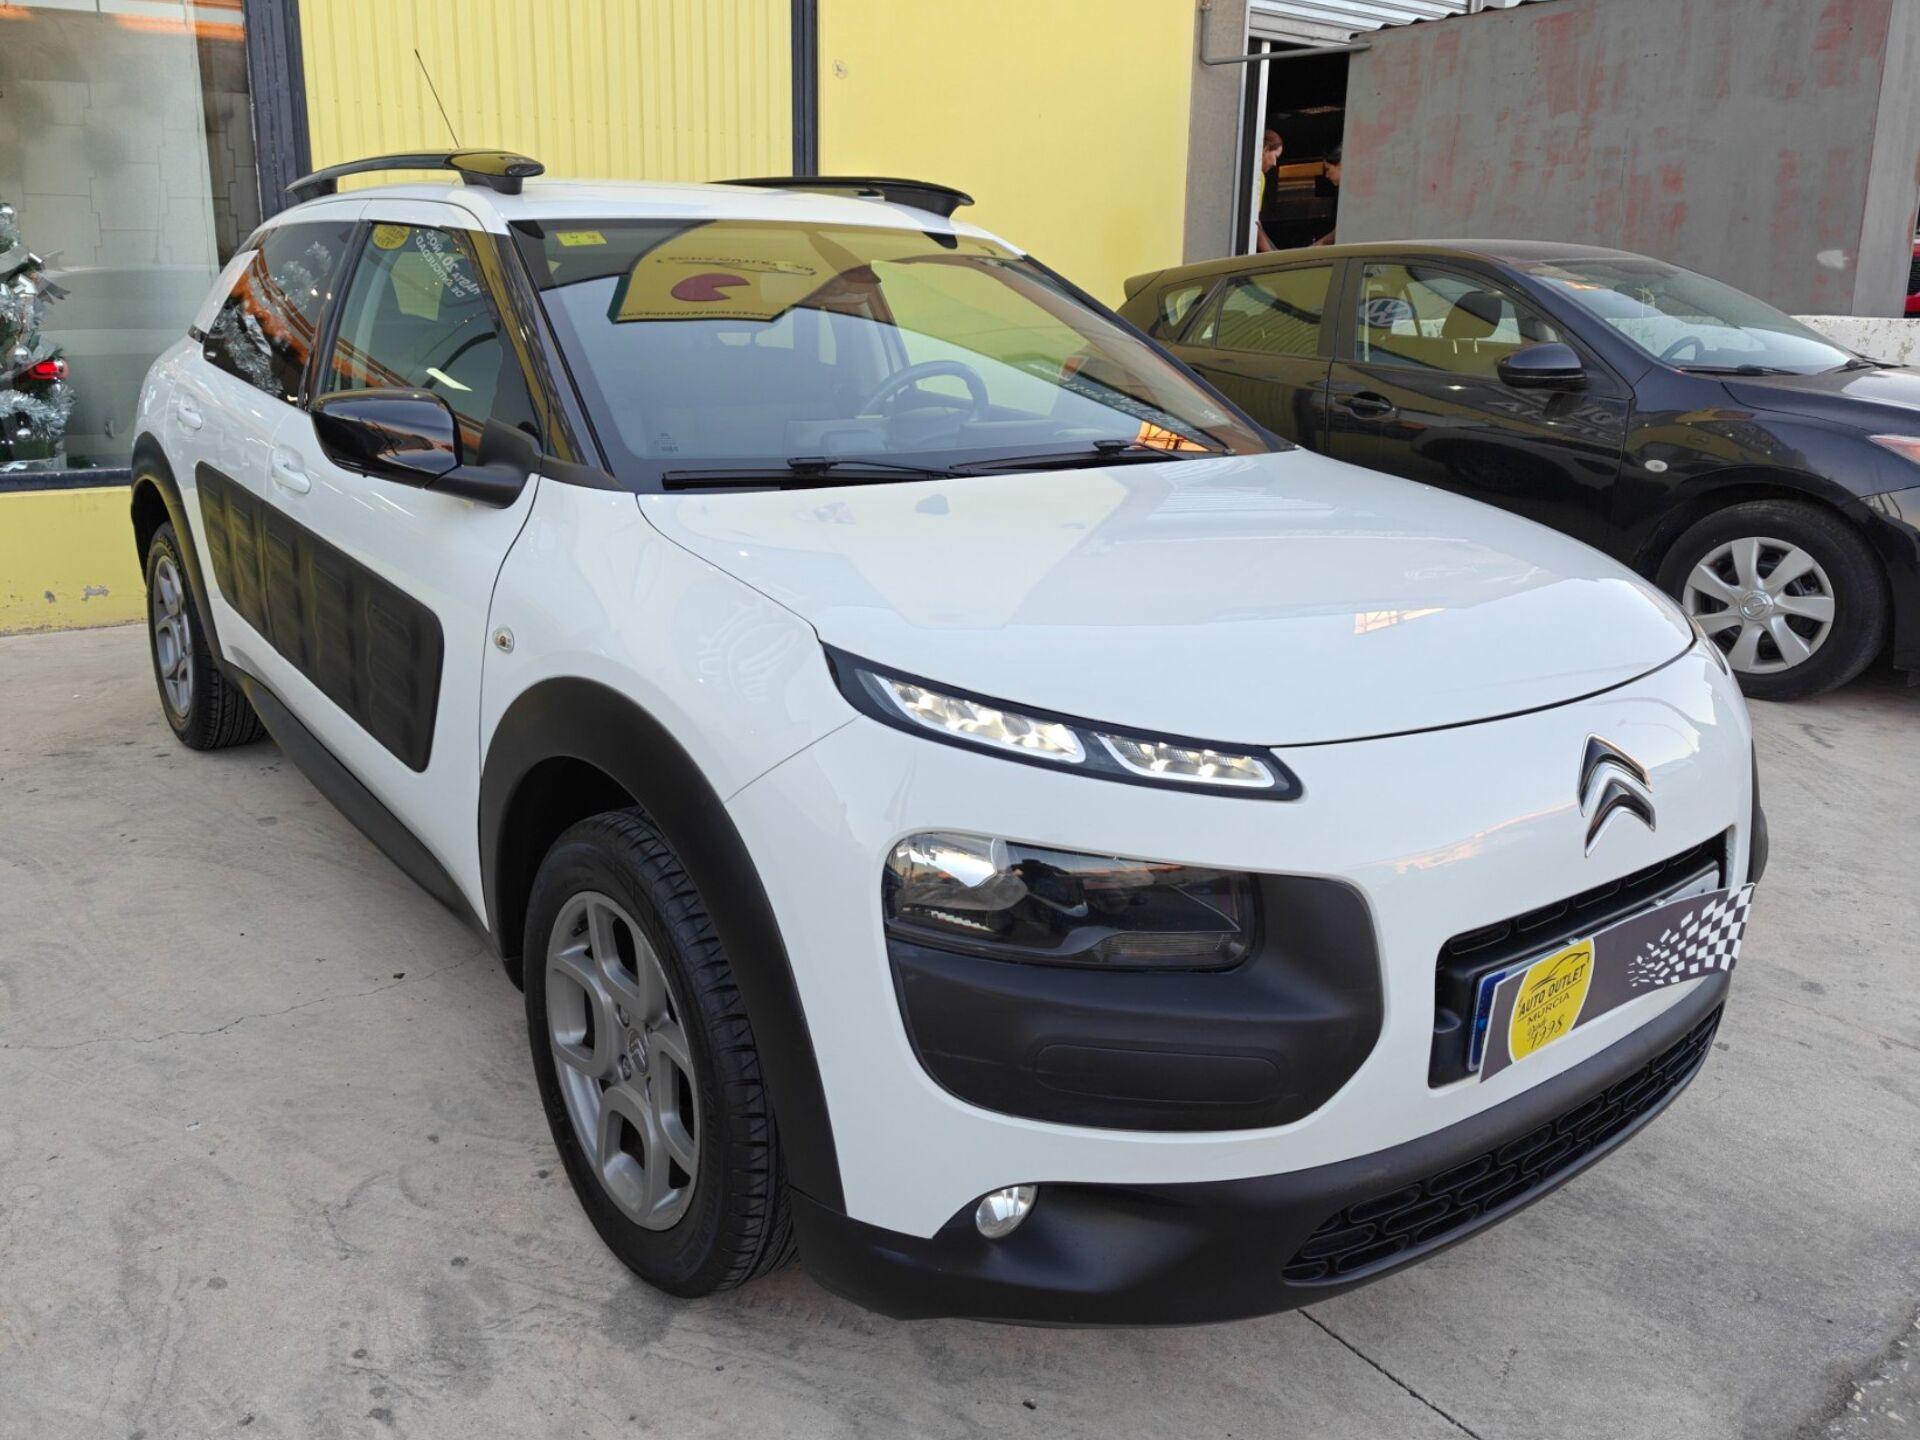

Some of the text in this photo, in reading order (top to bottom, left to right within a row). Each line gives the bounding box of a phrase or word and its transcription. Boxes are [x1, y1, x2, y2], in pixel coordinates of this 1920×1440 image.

[1518, 963, 1586, 1018] AUTO OUTLET
[1527, 991, 1570, 1025] MURCIA
